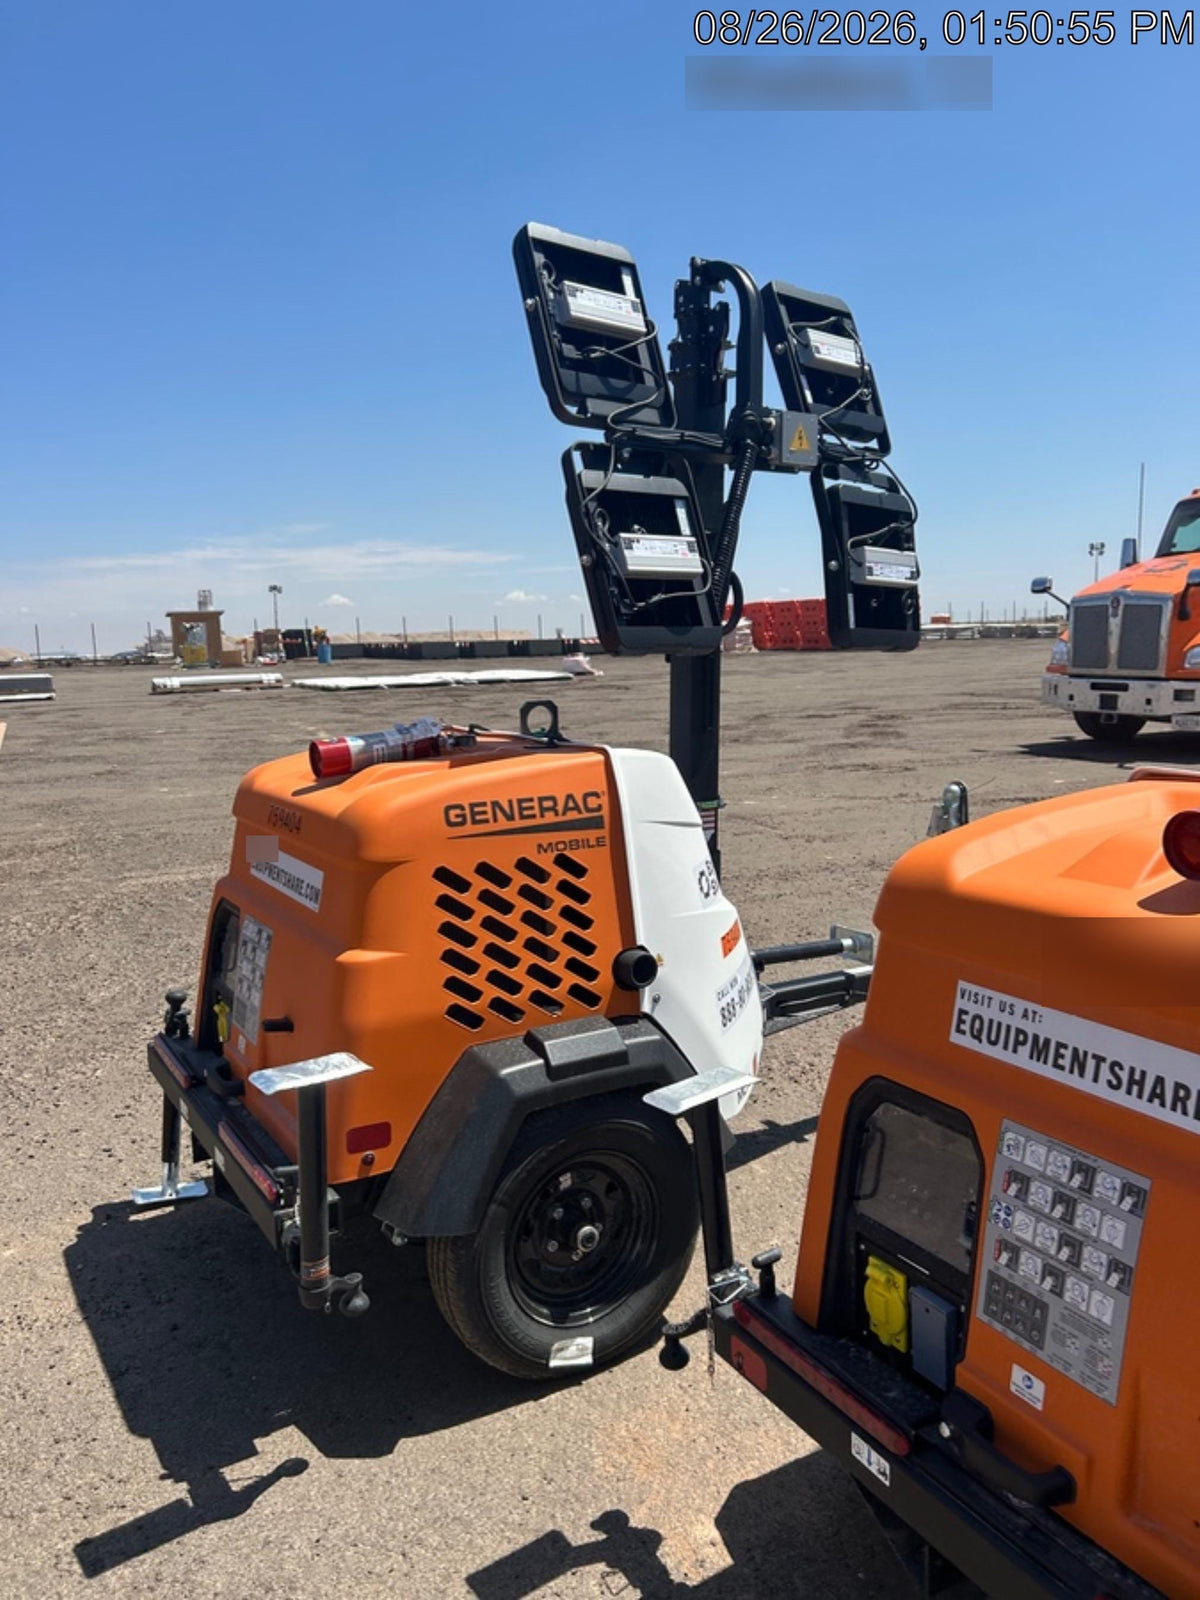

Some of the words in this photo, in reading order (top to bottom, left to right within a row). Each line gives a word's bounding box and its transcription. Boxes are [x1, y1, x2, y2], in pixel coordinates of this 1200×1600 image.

[443, 790, 604, 828] GENERAC
[536, 835, 607, 855] MOBILE
[959, 986, 993, 1010] VISIT
[998, 1000, 1015, 1017] US
[1021, 1007, 1044, 1024] AT:
